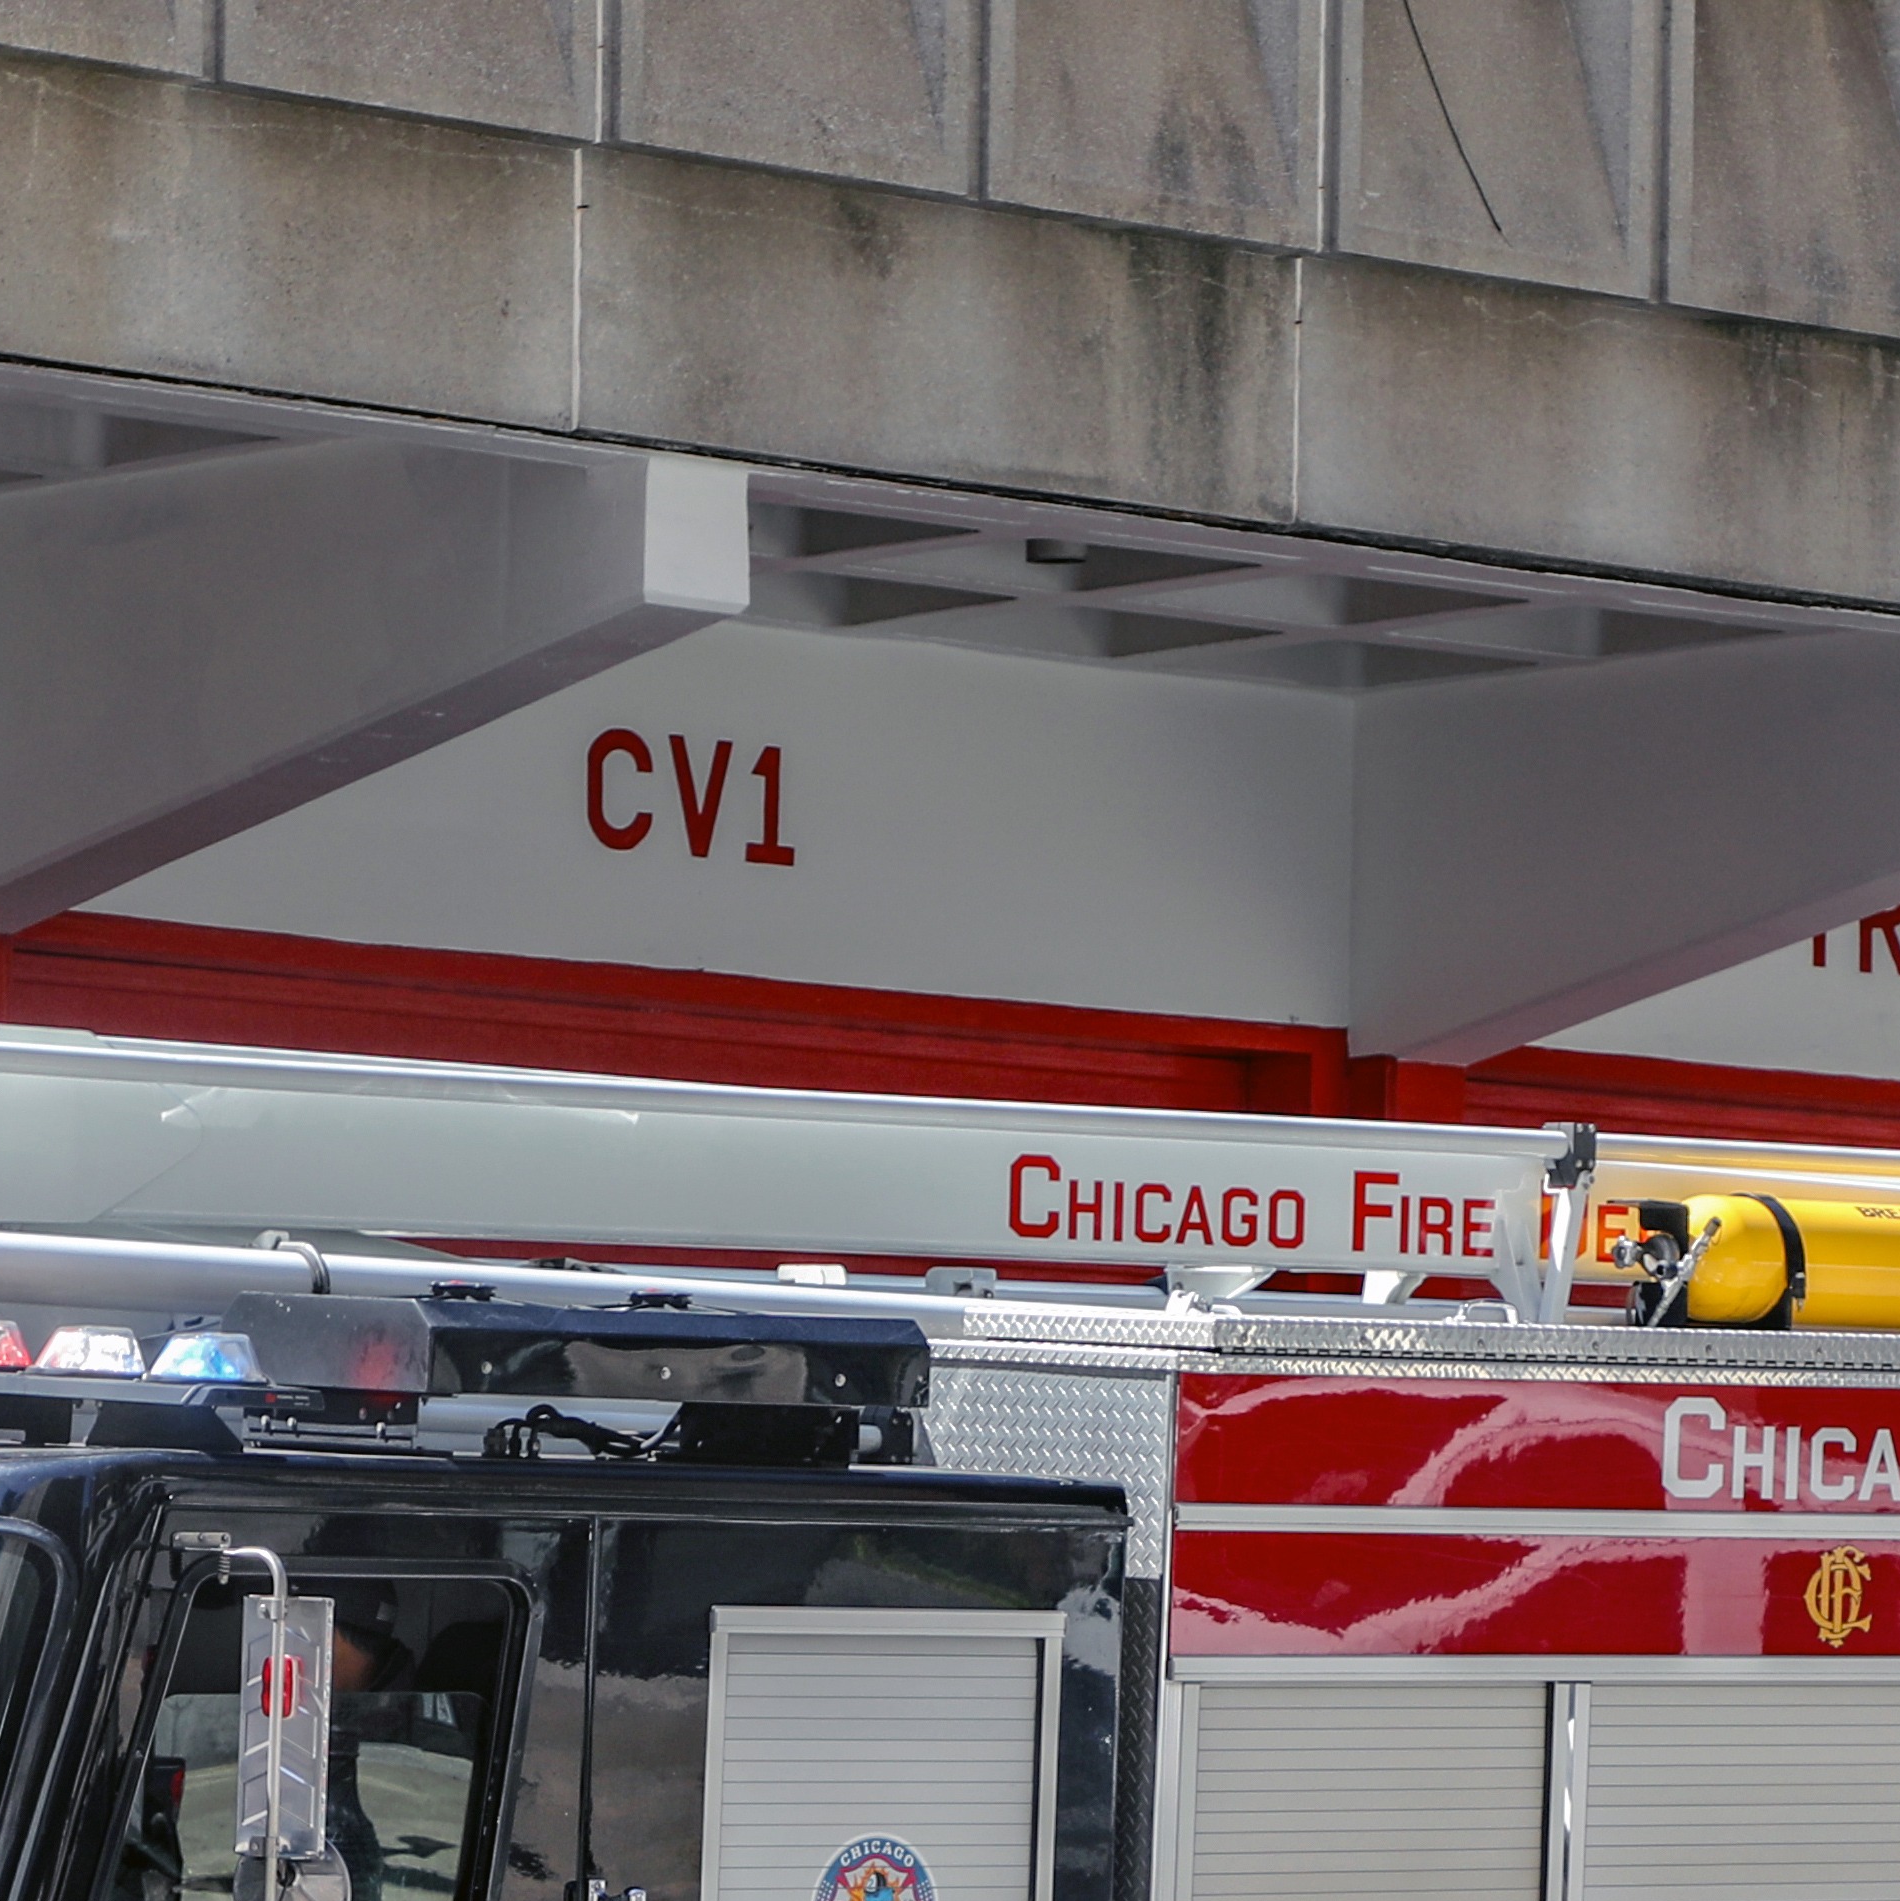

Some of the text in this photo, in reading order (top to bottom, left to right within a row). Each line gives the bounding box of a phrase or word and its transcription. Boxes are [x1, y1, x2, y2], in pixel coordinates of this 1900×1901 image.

[586, 727, 796, 867] CV1
[1008, 1153, 1306, 1250] CHICAGO
[1351, 1170, 1497, 1258] FIRE
[839, 1840, 916, 1868] CHICAGO
